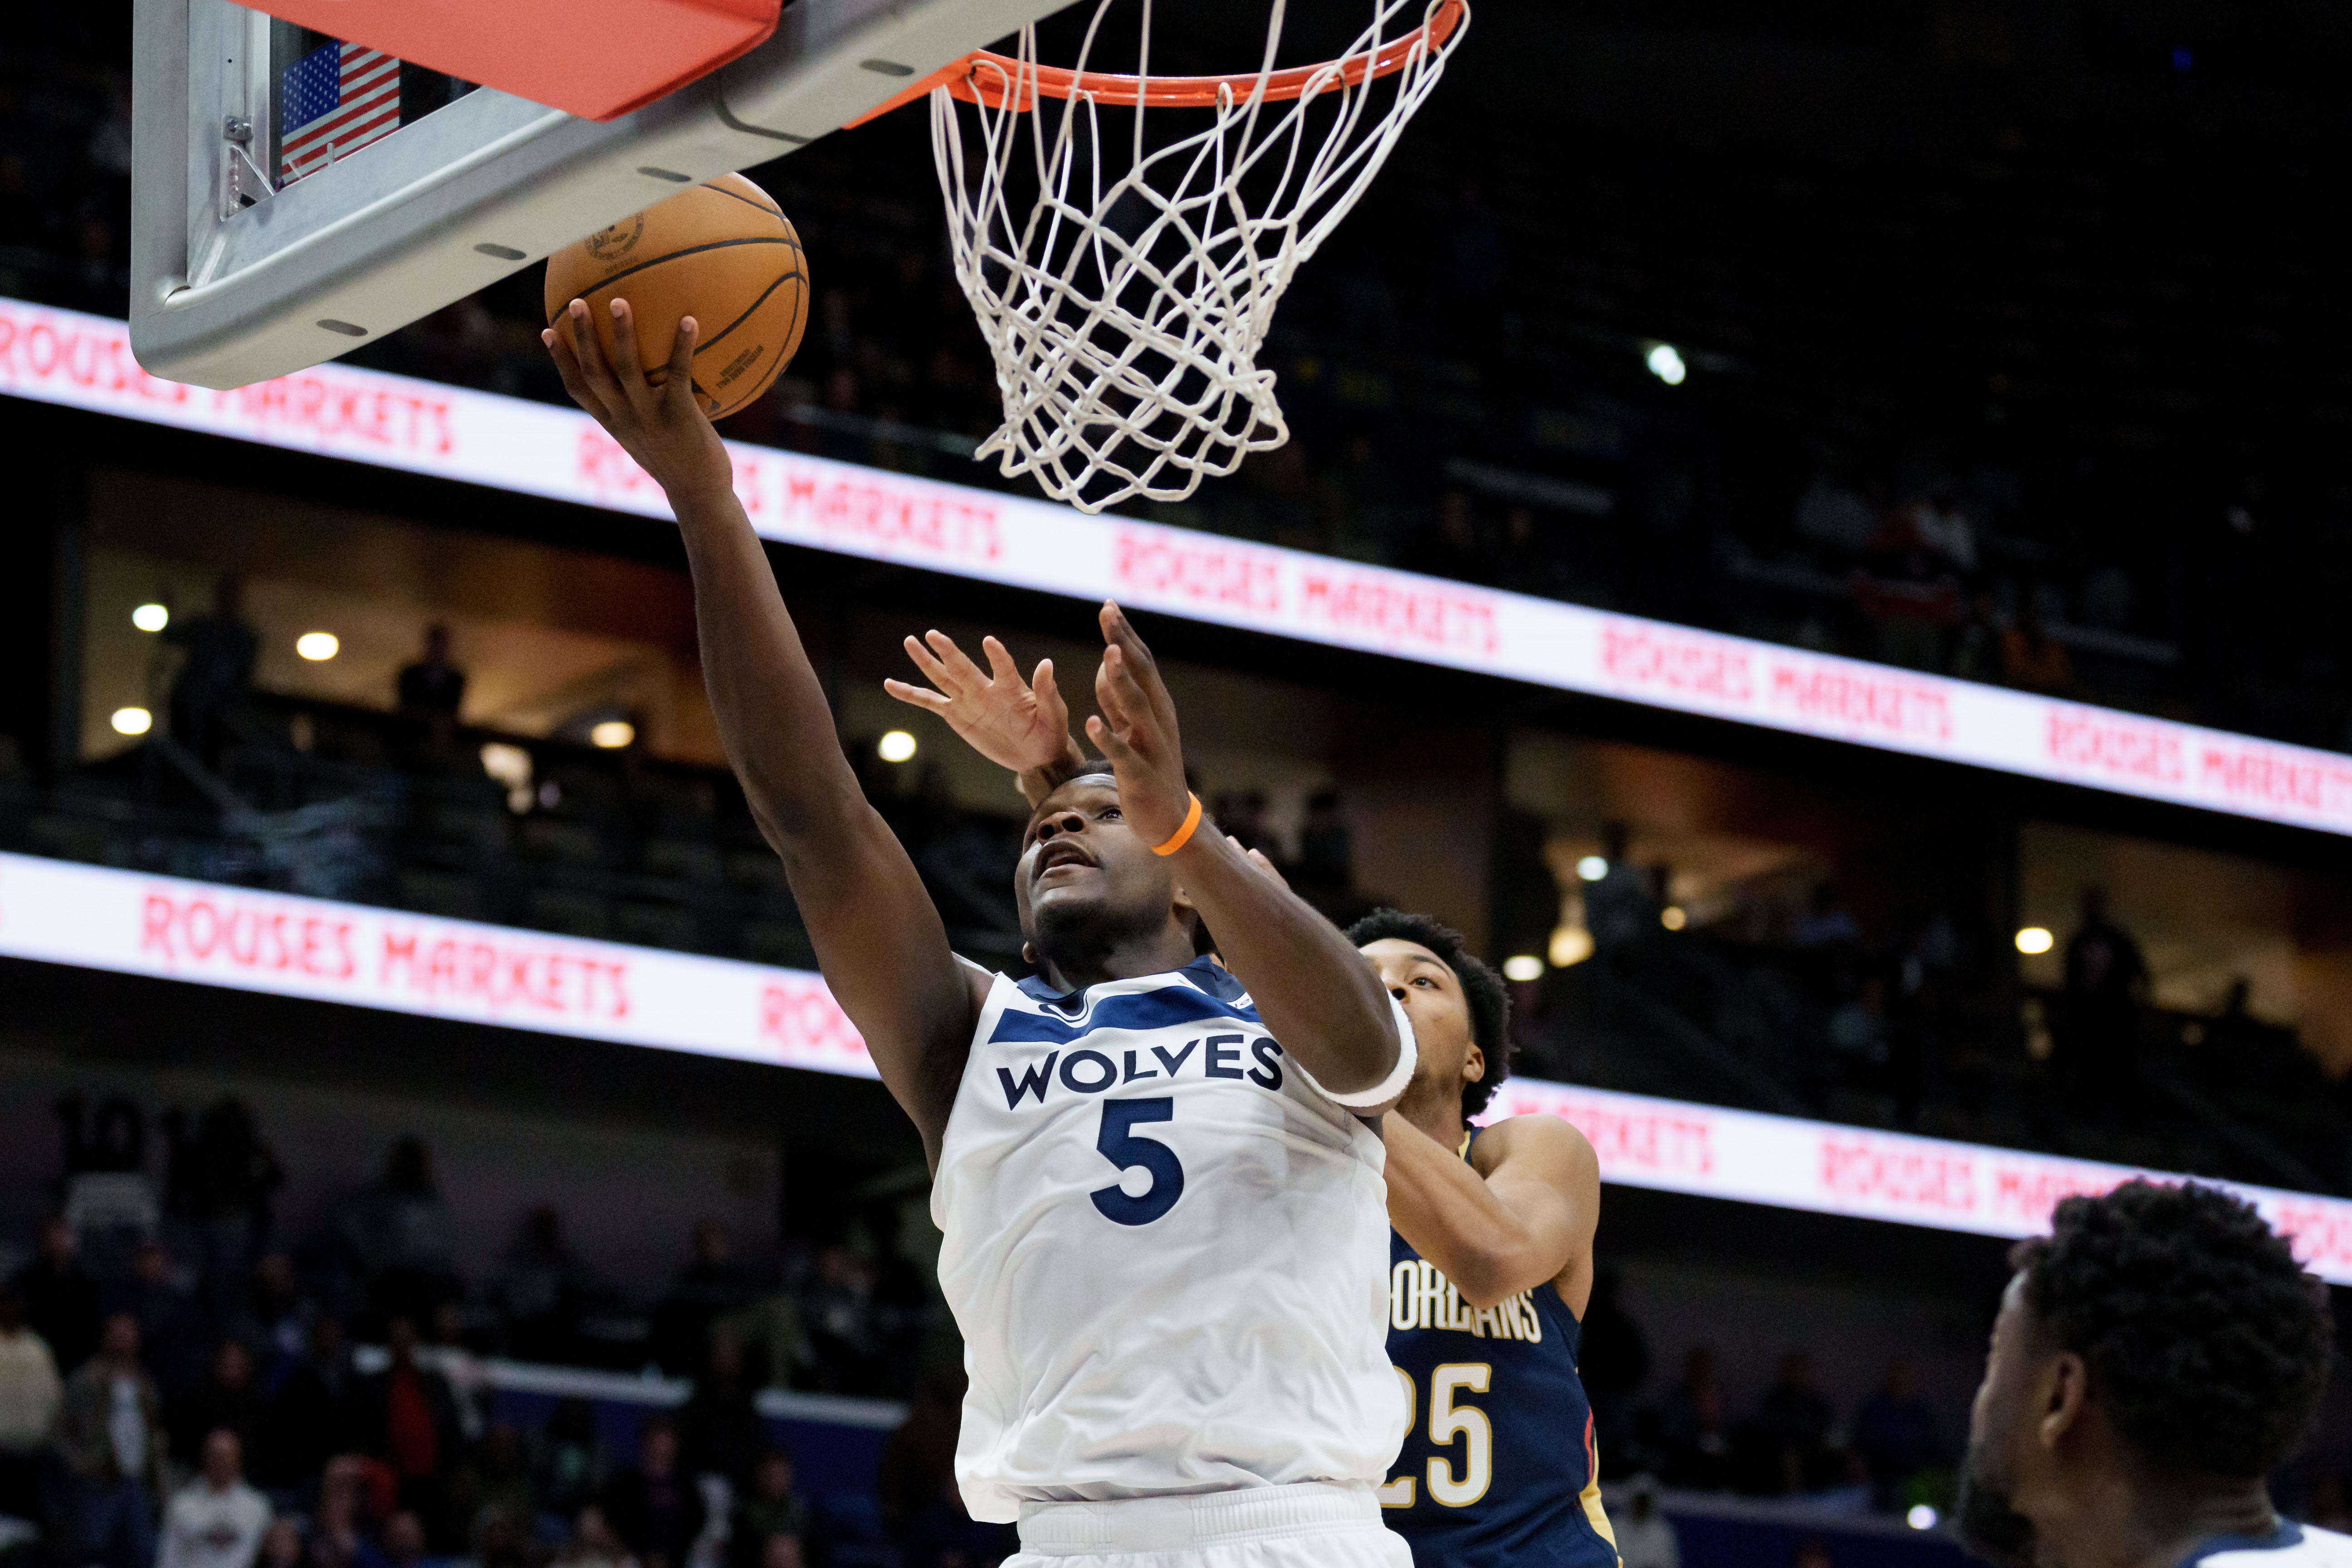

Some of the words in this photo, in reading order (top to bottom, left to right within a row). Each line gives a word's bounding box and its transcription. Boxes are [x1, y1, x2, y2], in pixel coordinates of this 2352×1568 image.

[142, 894, 356, 980] ROUSES
[379, 930, 628, 1018] MARKETS
[996, 1033, 1283, 1111] WOLVES
[1089, 1096, 1185, 1226] 5
[1391, 1259, 1542, 1343] ORLANS
